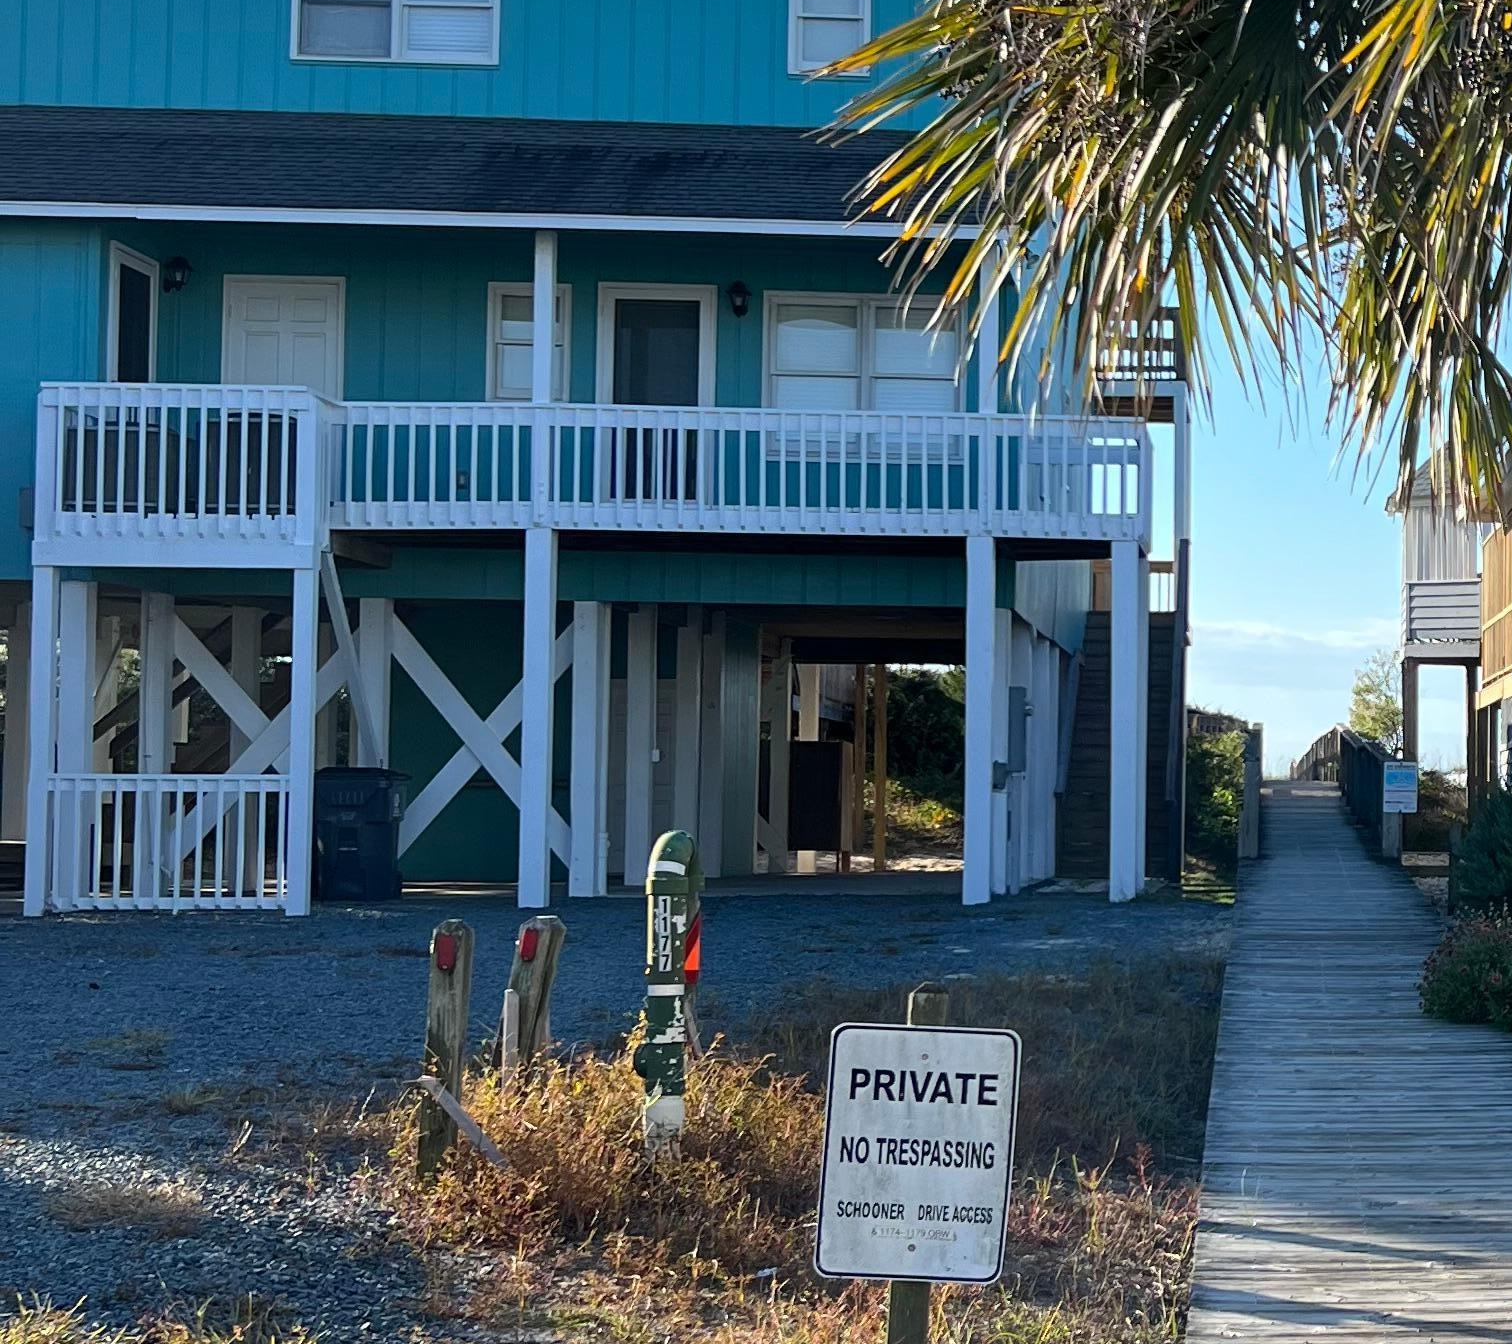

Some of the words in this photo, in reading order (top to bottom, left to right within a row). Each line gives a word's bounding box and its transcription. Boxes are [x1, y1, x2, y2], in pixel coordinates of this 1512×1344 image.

[660, 897, 670, 971] 1177
[849, 1067, 1000, 1107] PRIVATE
[839, 1135, 870, 1164] NO
[875, 1136, 996, 1170] TRESPASSING
[836, 1199, 905, 1221] SCHOONER
[917, 1203, 950, 1223] DRIVE
[951, 1206, 994, 1225] ACCESS
